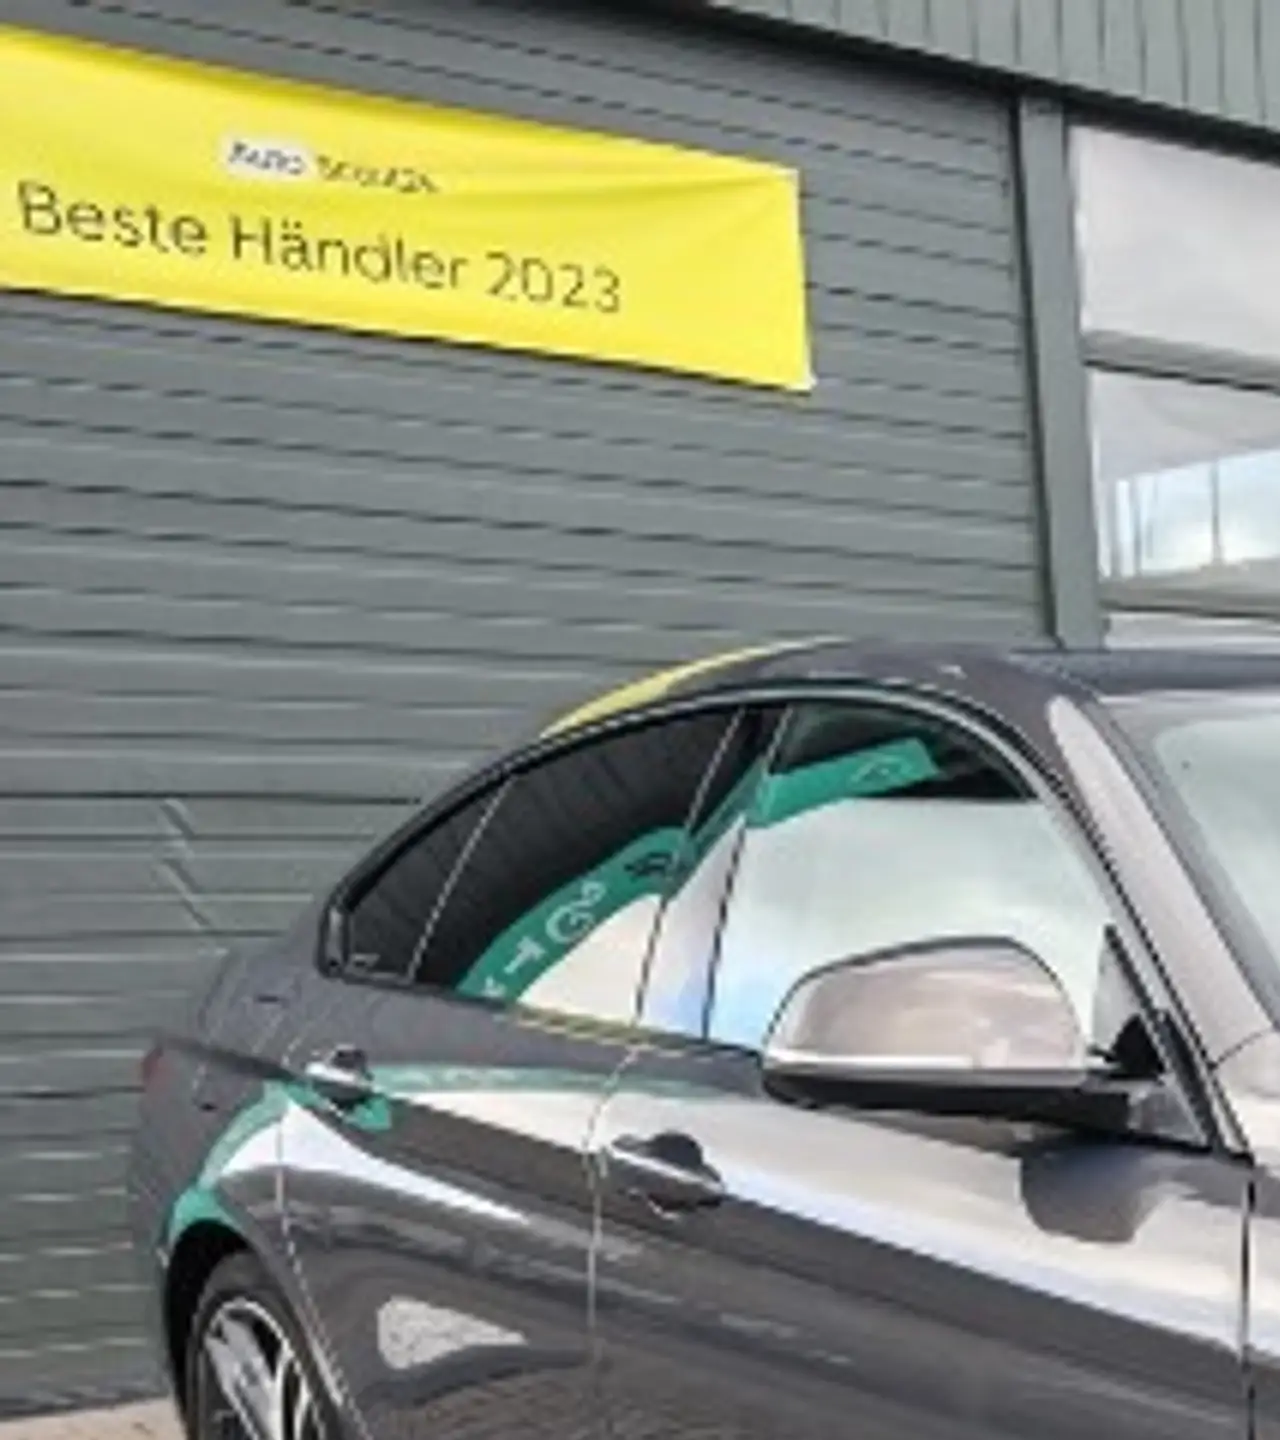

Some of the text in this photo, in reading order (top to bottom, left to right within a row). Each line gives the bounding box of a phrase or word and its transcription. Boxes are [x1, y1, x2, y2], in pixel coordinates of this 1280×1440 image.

[18, 181, 620, 313] Beste Händler 2023
